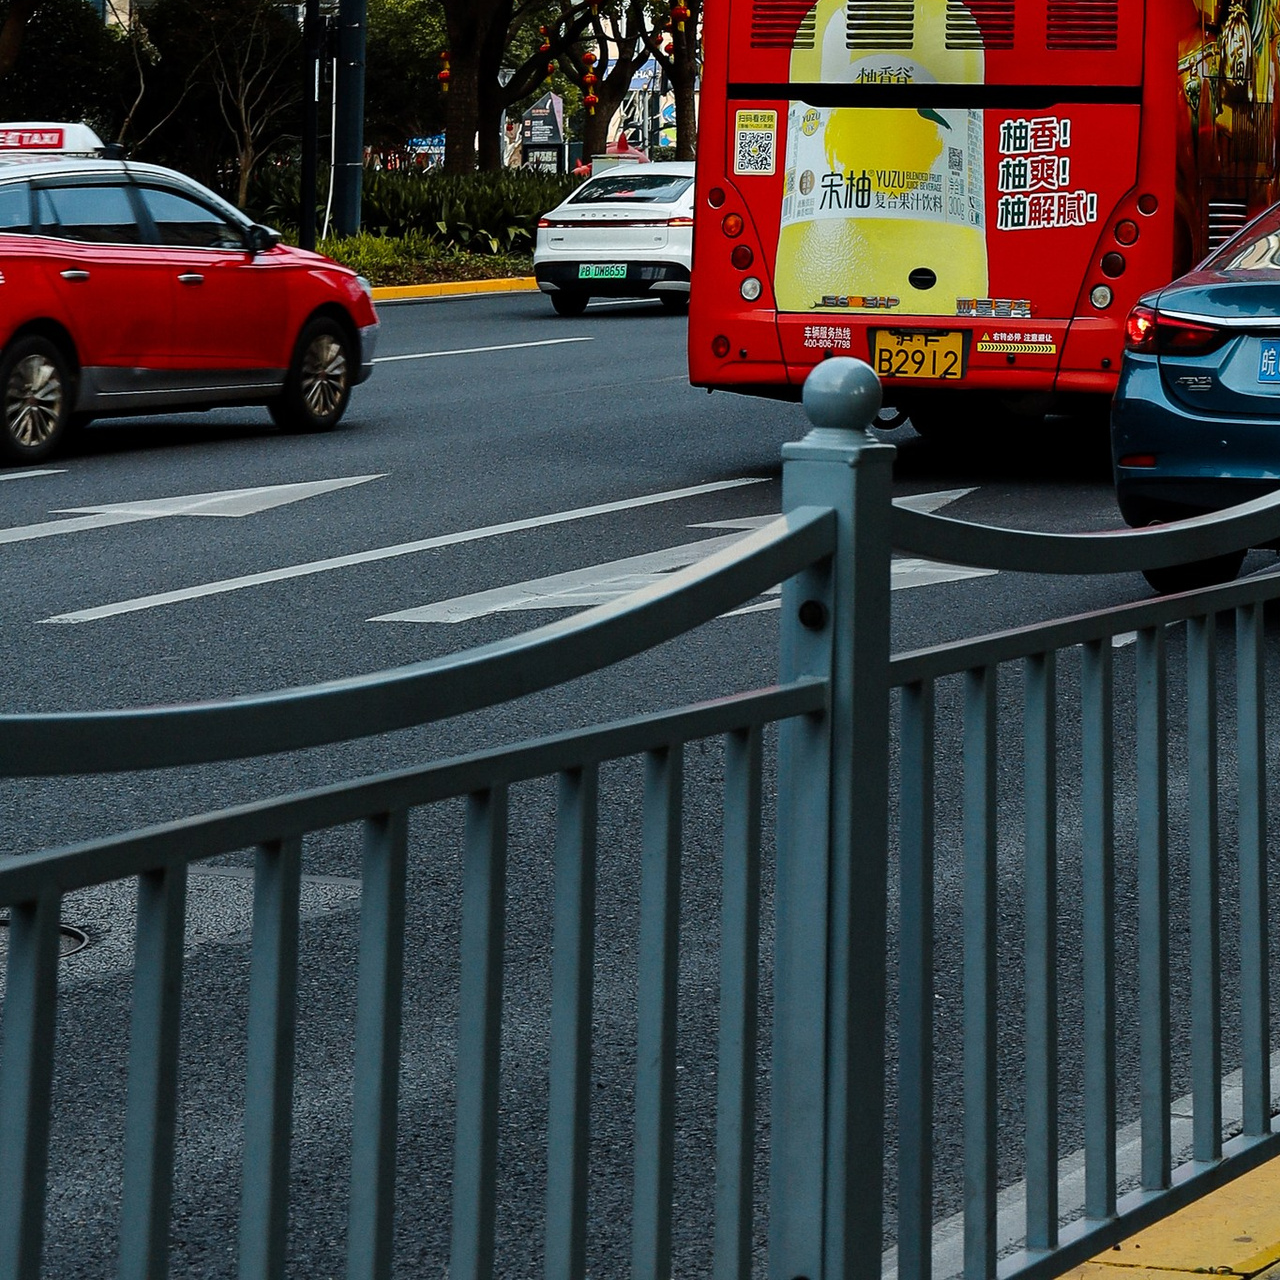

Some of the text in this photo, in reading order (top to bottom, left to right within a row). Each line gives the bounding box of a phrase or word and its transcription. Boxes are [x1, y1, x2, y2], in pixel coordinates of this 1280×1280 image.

[21, 132, 60, 145] TAXI
[999, 116, 1071, 154] 柚香!
[876, 170, 905, 189] YUZU
[998, 154, 1070, 191] 柚爽!
[819, 170, 872, 210] 宋柚
[875, 191, 943, 213] 复合果汁饮料
[997, 191, 1098, 230] 柚解腻!
[803, 325, 851, 340] 车辆服务热线
[803, 338, 851, 349] 400-806-7798
[992, 332, 1053, 343] 右转必停 注意避让
[878, 348, 959, 377] B2912
